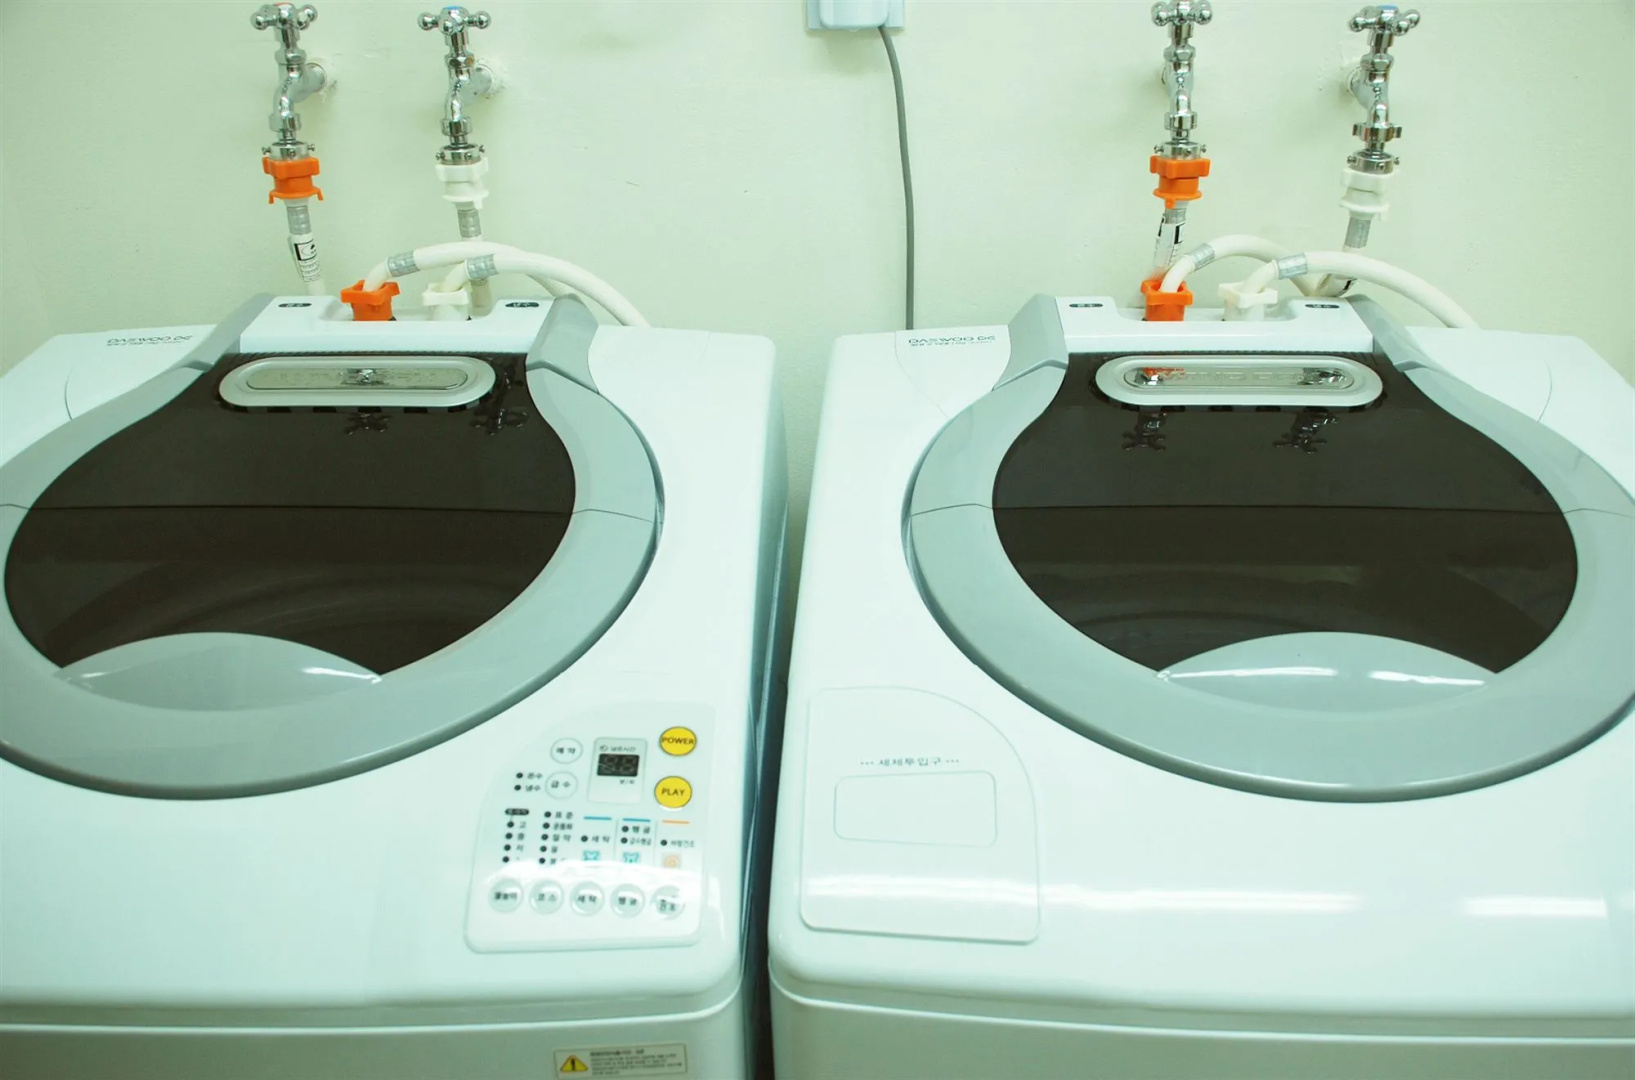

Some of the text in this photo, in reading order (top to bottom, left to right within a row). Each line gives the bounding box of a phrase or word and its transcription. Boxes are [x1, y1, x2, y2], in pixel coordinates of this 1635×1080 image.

[662, 736, 695, 746] POWER
[879, 757, 942, 767] 세제투입구
[661, 787, 686, 797] PLAY
[538, 893, 557, 902] 코스
[578, 894, 597, 903] 세탁
